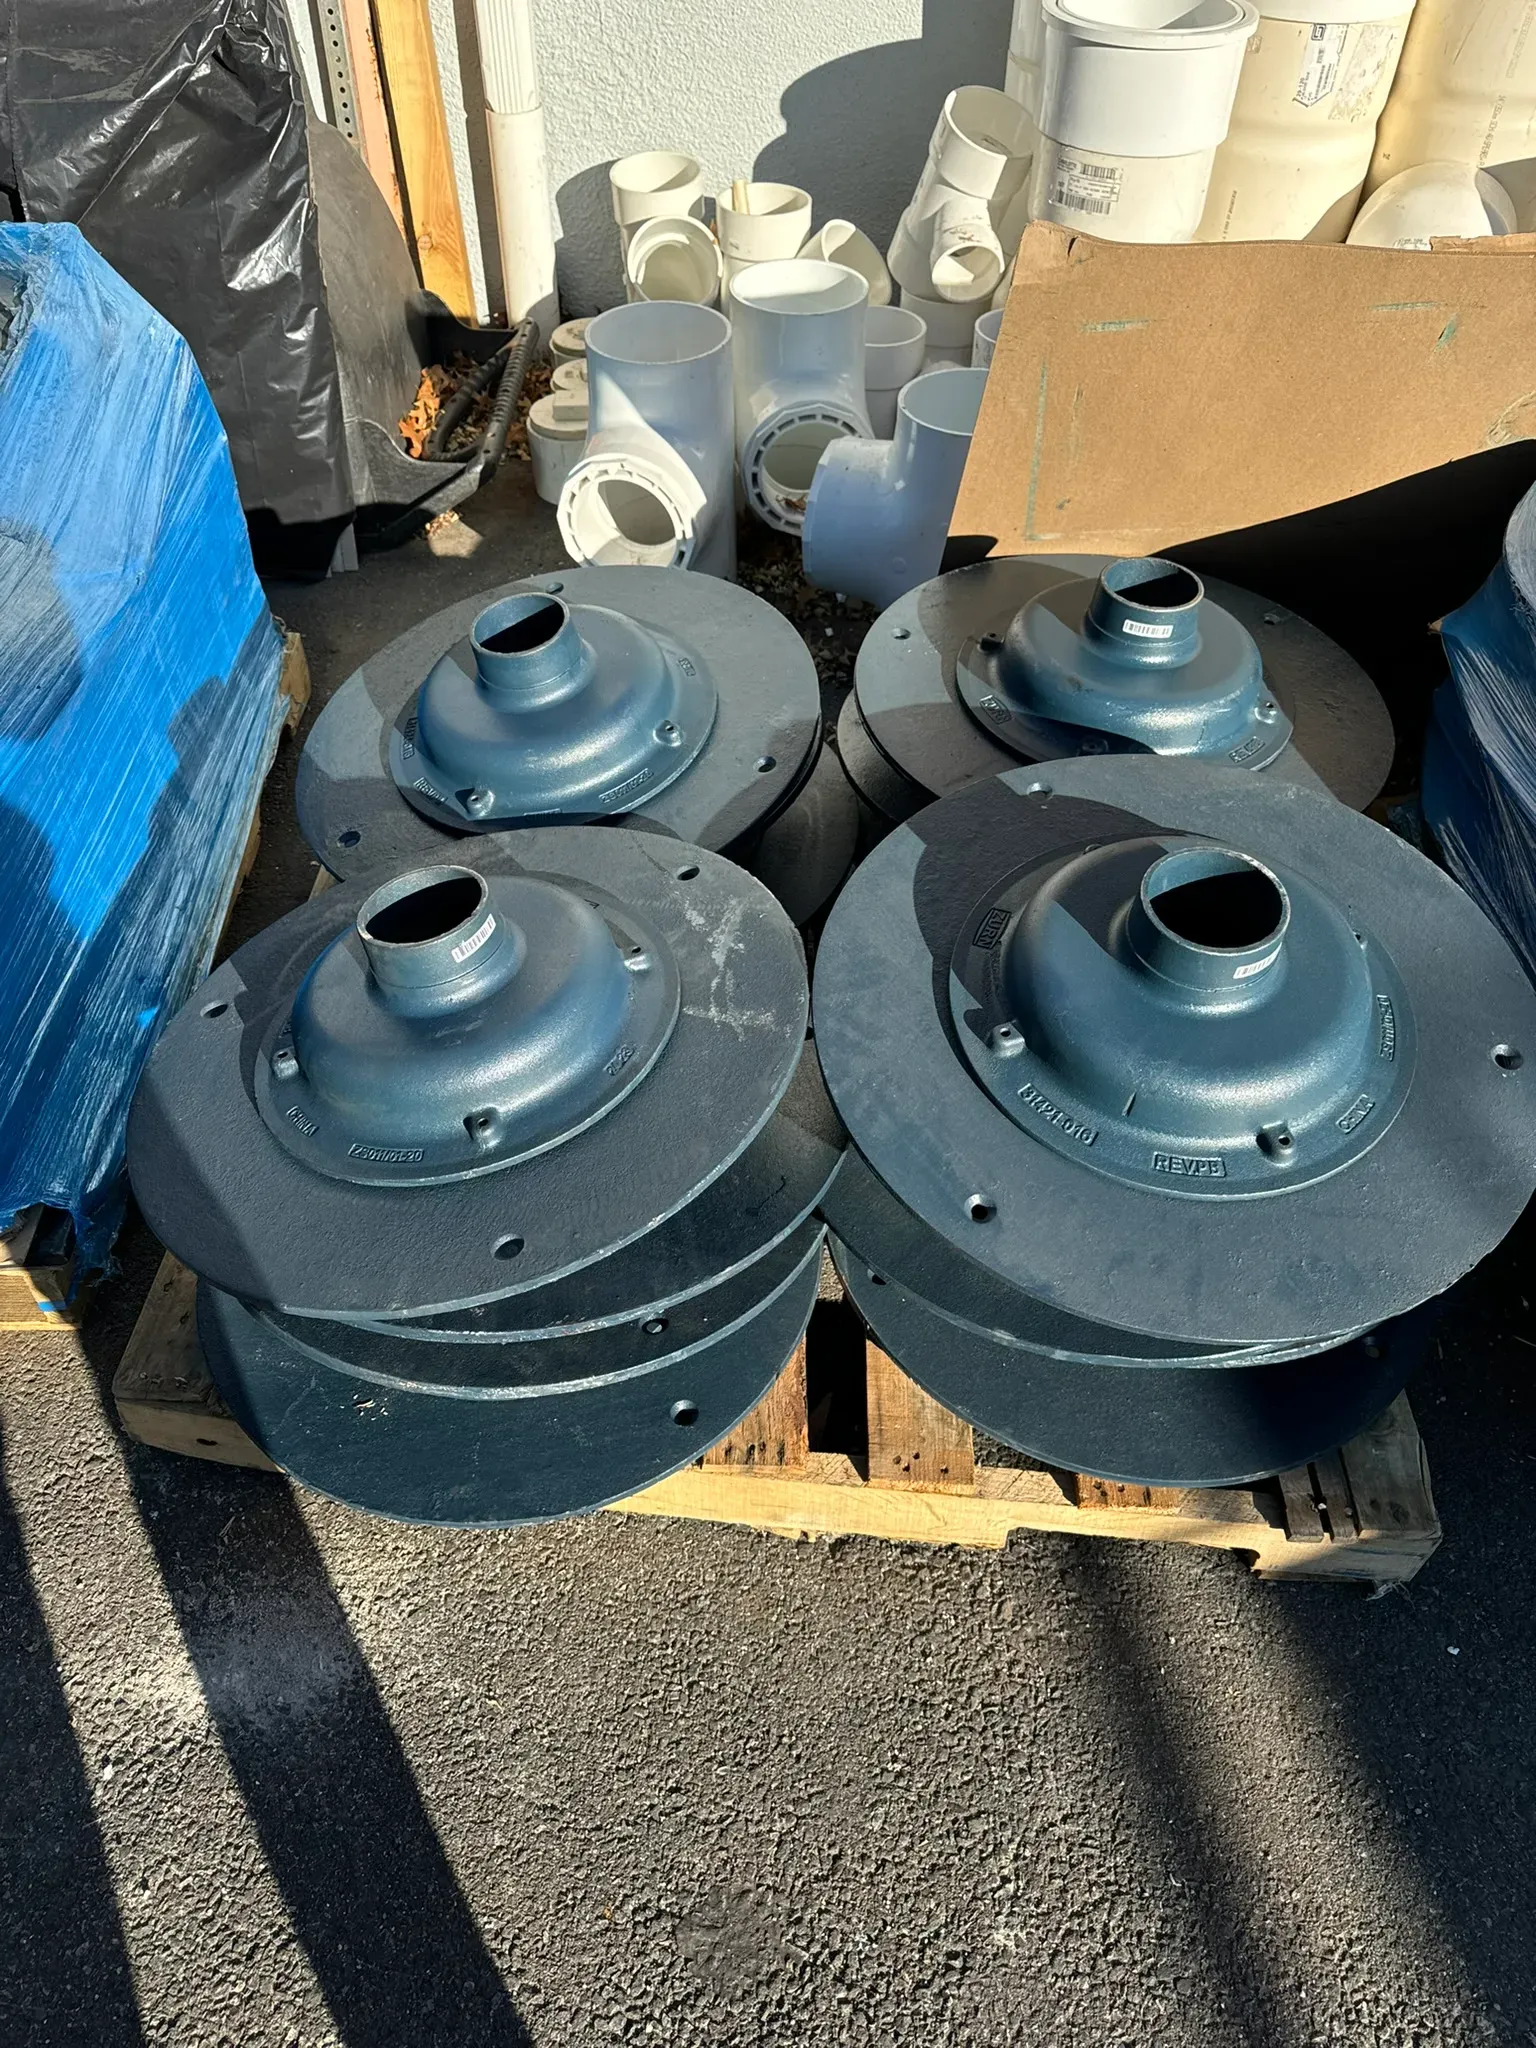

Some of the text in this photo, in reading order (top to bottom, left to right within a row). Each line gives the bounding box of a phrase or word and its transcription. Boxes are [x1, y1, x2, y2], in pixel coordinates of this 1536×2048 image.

[977, 909, 1009, 948] ZURN
[287, 1106, 318, 1137] CHINA
[1337, 1096, 1374, 1133] CHINA
